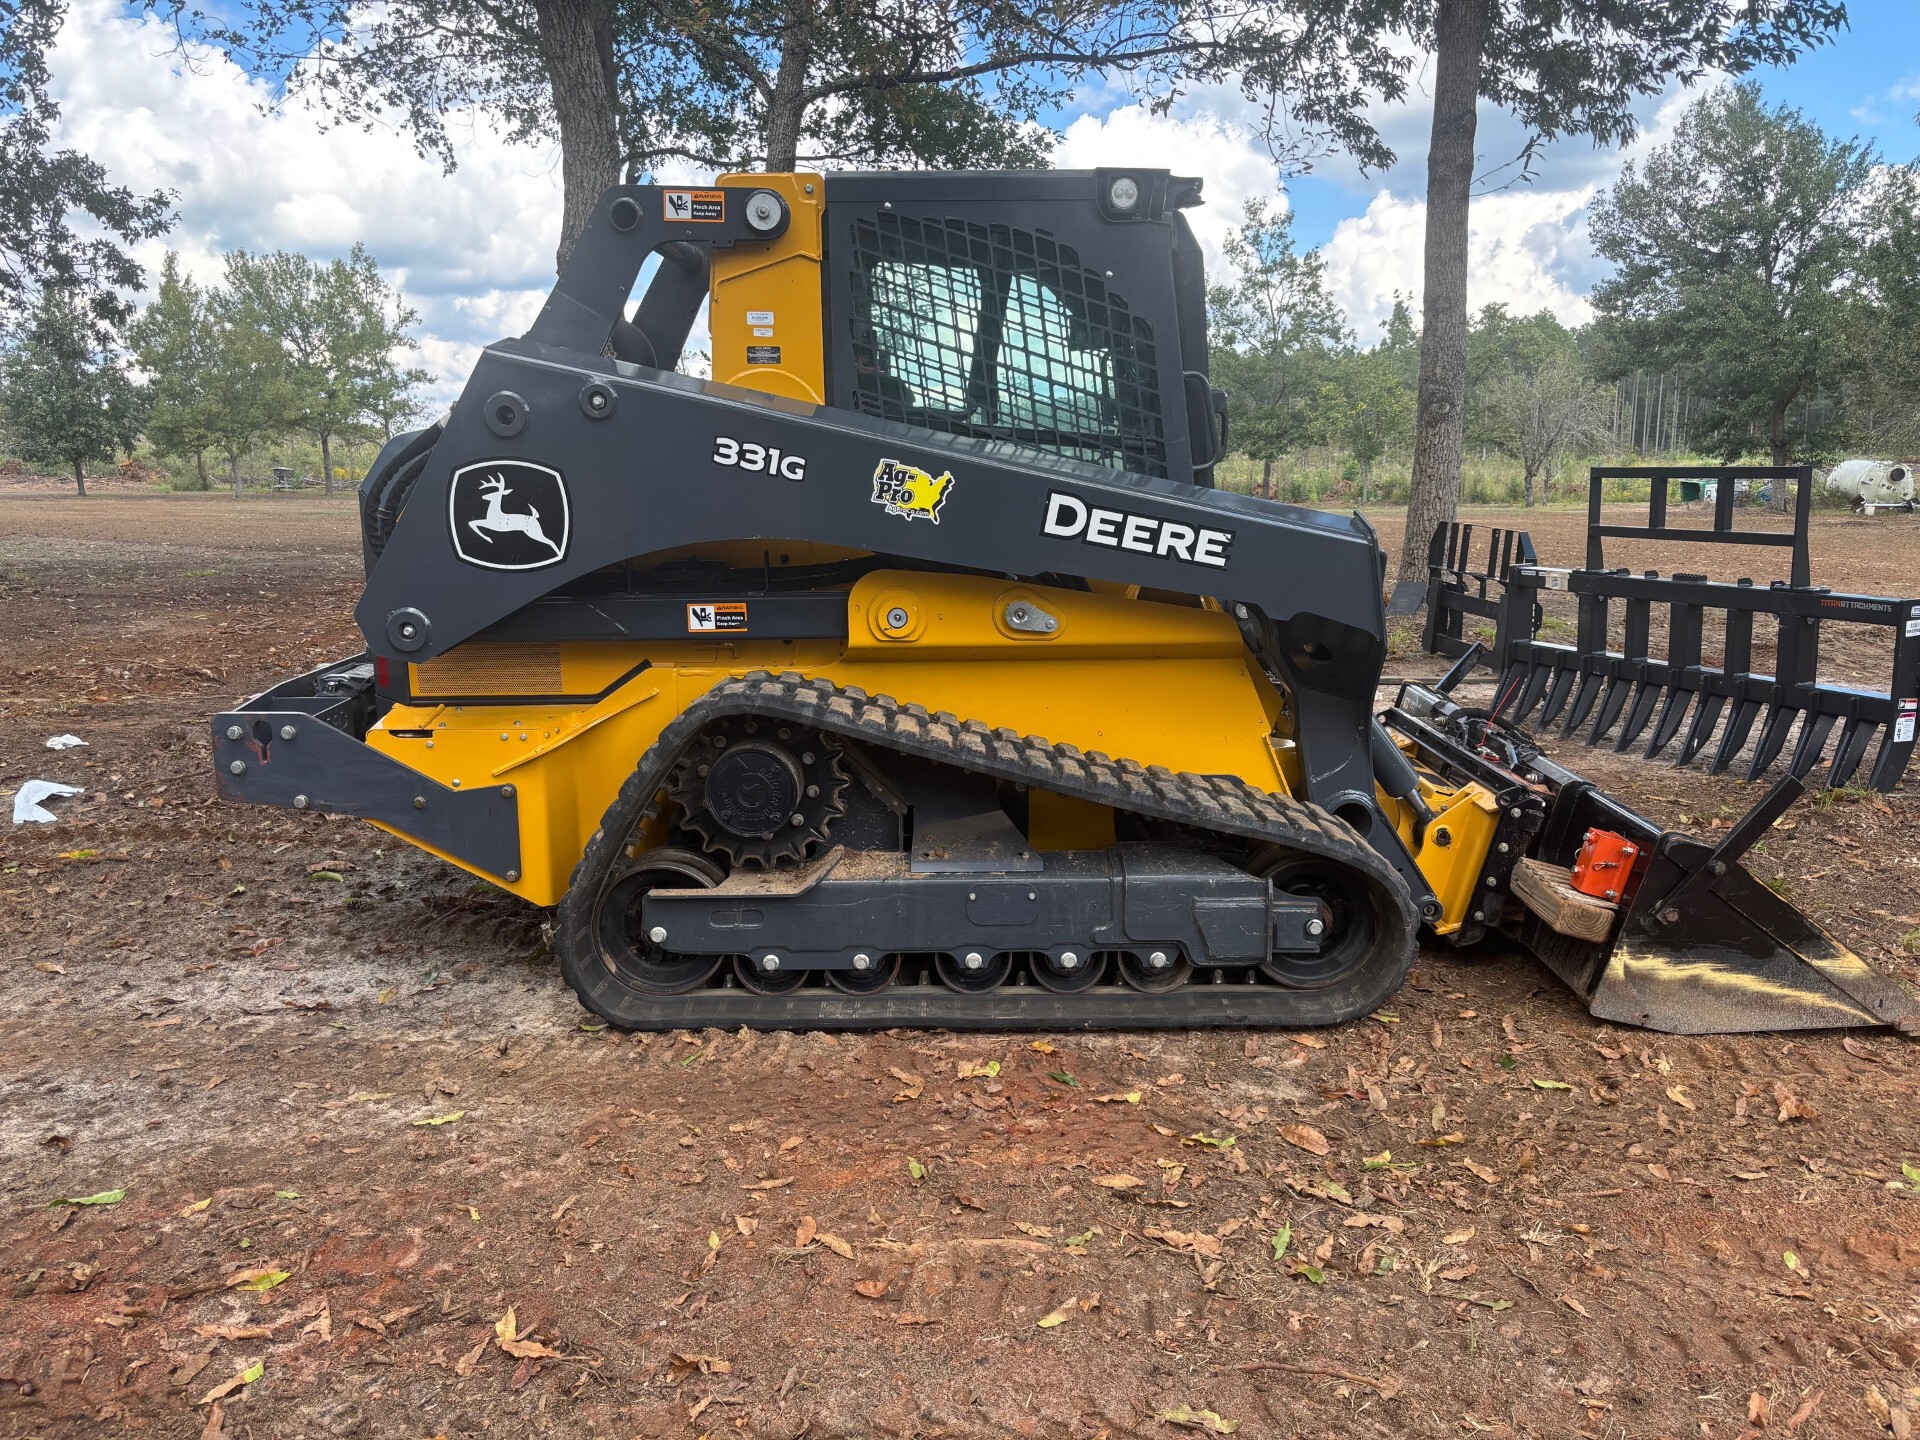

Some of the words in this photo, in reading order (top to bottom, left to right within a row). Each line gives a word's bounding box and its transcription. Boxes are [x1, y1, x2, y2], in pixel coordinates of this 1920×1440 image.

[713, 437, 806, 480] 331G
[877, 462, 917, 488] Ag-
[875, 481, 915, 504] Pro
[887, 504, 930, 517] AgProCo.com
[1043, 492, 1232, 567] DEERE
